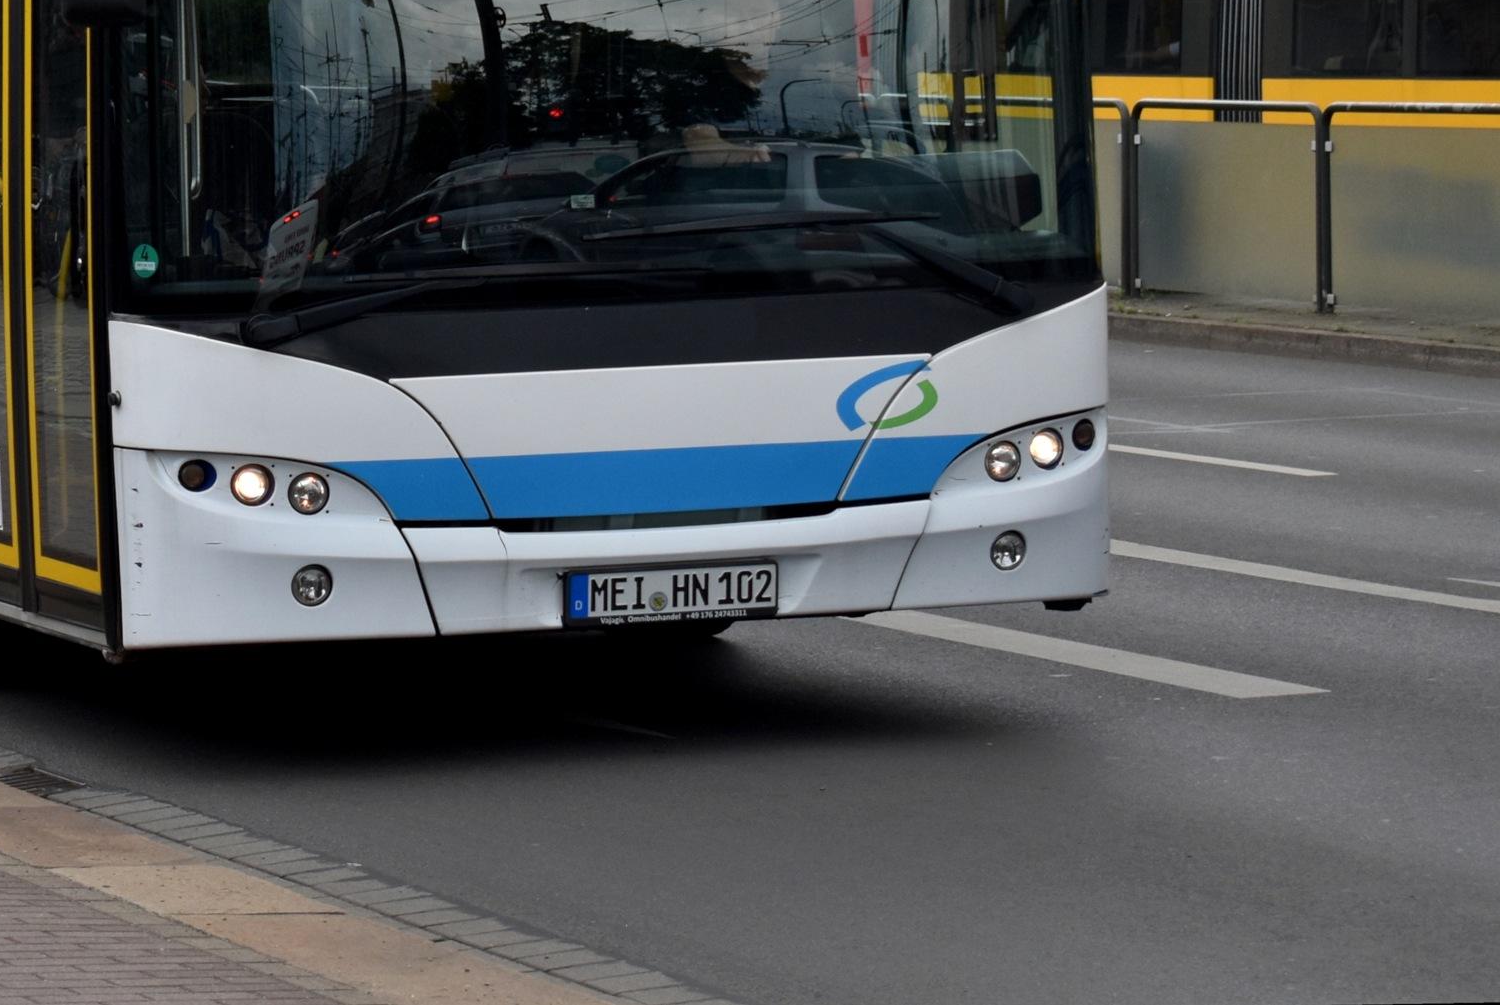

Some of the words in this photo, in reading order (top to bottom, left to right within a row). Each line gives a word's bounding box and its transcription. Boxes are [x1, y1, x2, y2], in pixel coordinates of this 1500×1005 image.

[141, 246, 149, 261] 4
[590, 577, 646, 612] MEI
[672, 573, 710, 607] HN
[718, 570, 772, 605] 102
[575, 601, 582, 610] D
[628, 613, 681, 623] Omnibushandel
